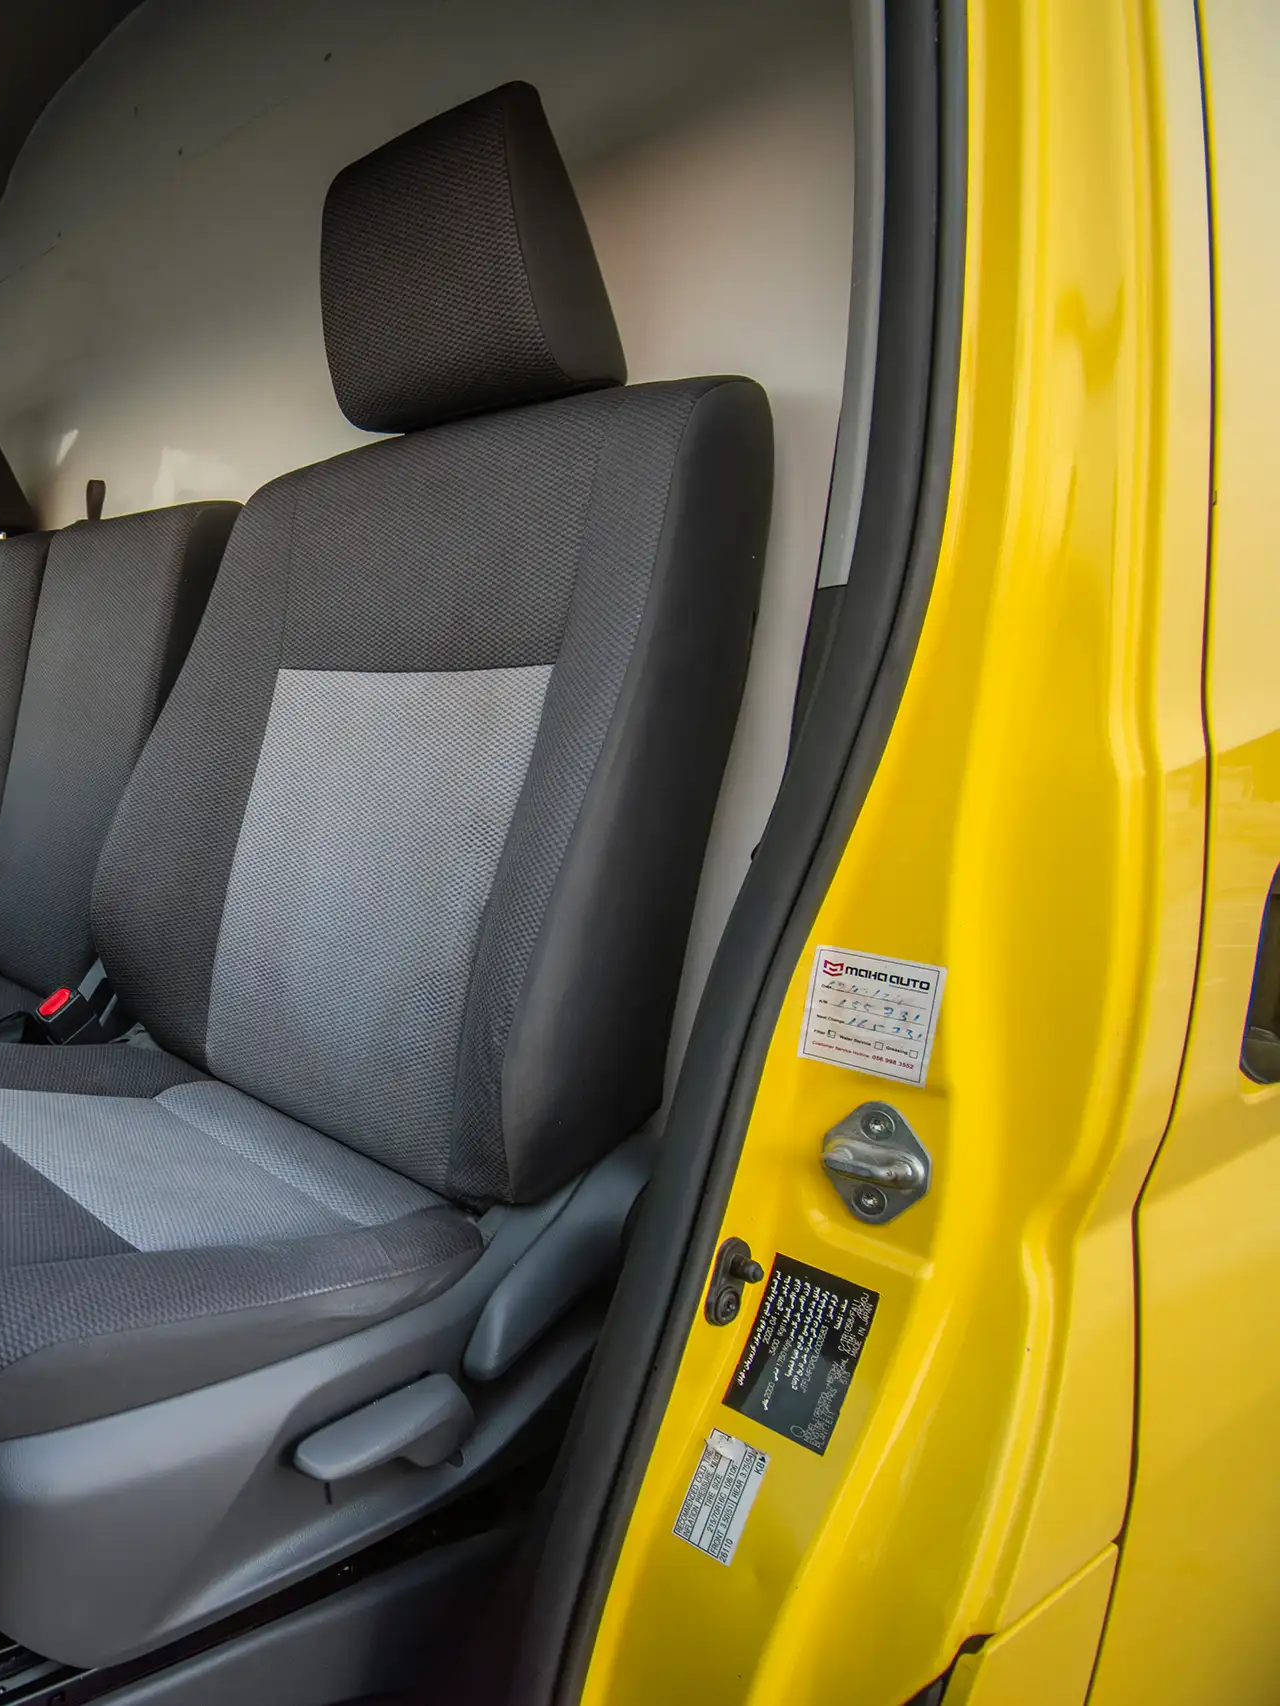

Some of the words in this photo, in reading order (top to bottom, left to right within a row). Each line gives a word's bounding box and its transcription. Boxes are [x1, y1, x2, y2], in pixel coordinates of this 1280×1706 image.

[675, 1484, 699, 1534] RECOMMENDED
[695, 1464, 707, 1483] COLD
[682, 1504, 699, 1538] INFLATION
[695, 1470, 713, 1504] PRESSURE
[704, 1491, 715, 1507] TIRE
[711, 1472, 722, 1489] SIZE
[706, 1491, 727, 1533] 215/70R16C
[710, 1529, 723, 1554] FRONT
[731, 1478, 743, 1498] REAR
